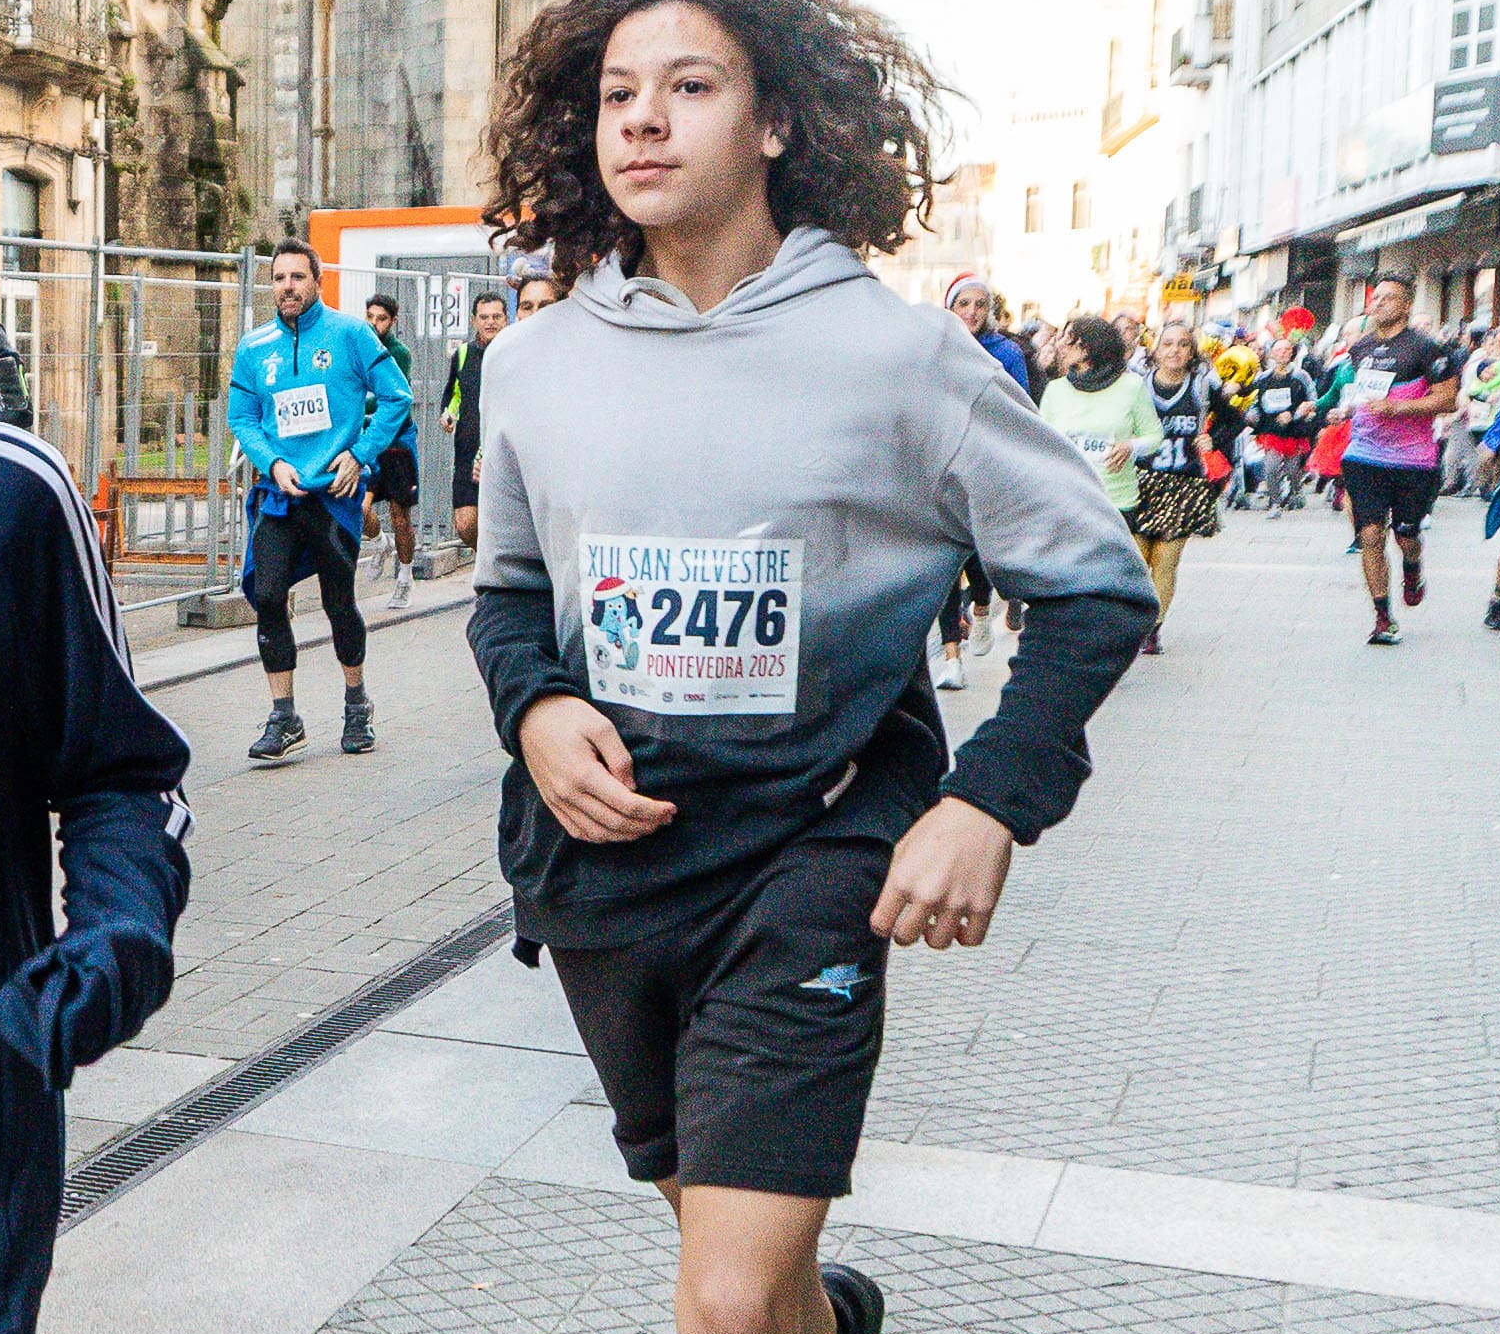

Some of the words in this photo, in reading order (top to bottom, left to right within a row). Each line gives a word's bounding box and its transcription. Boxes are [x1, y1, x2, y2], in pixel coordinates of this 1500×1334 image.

[265, 362, 277, 386] 2
[291, 398, 325, 416] 3703
[629, 547, 671, 581] SAN
[679, 549, 791, 584] SILVESTRE
[650, 588, 788, 648] 2476
[647, 653, 744, 680] PONTEVEDRA
[748, 654, 786, 678] 2025
